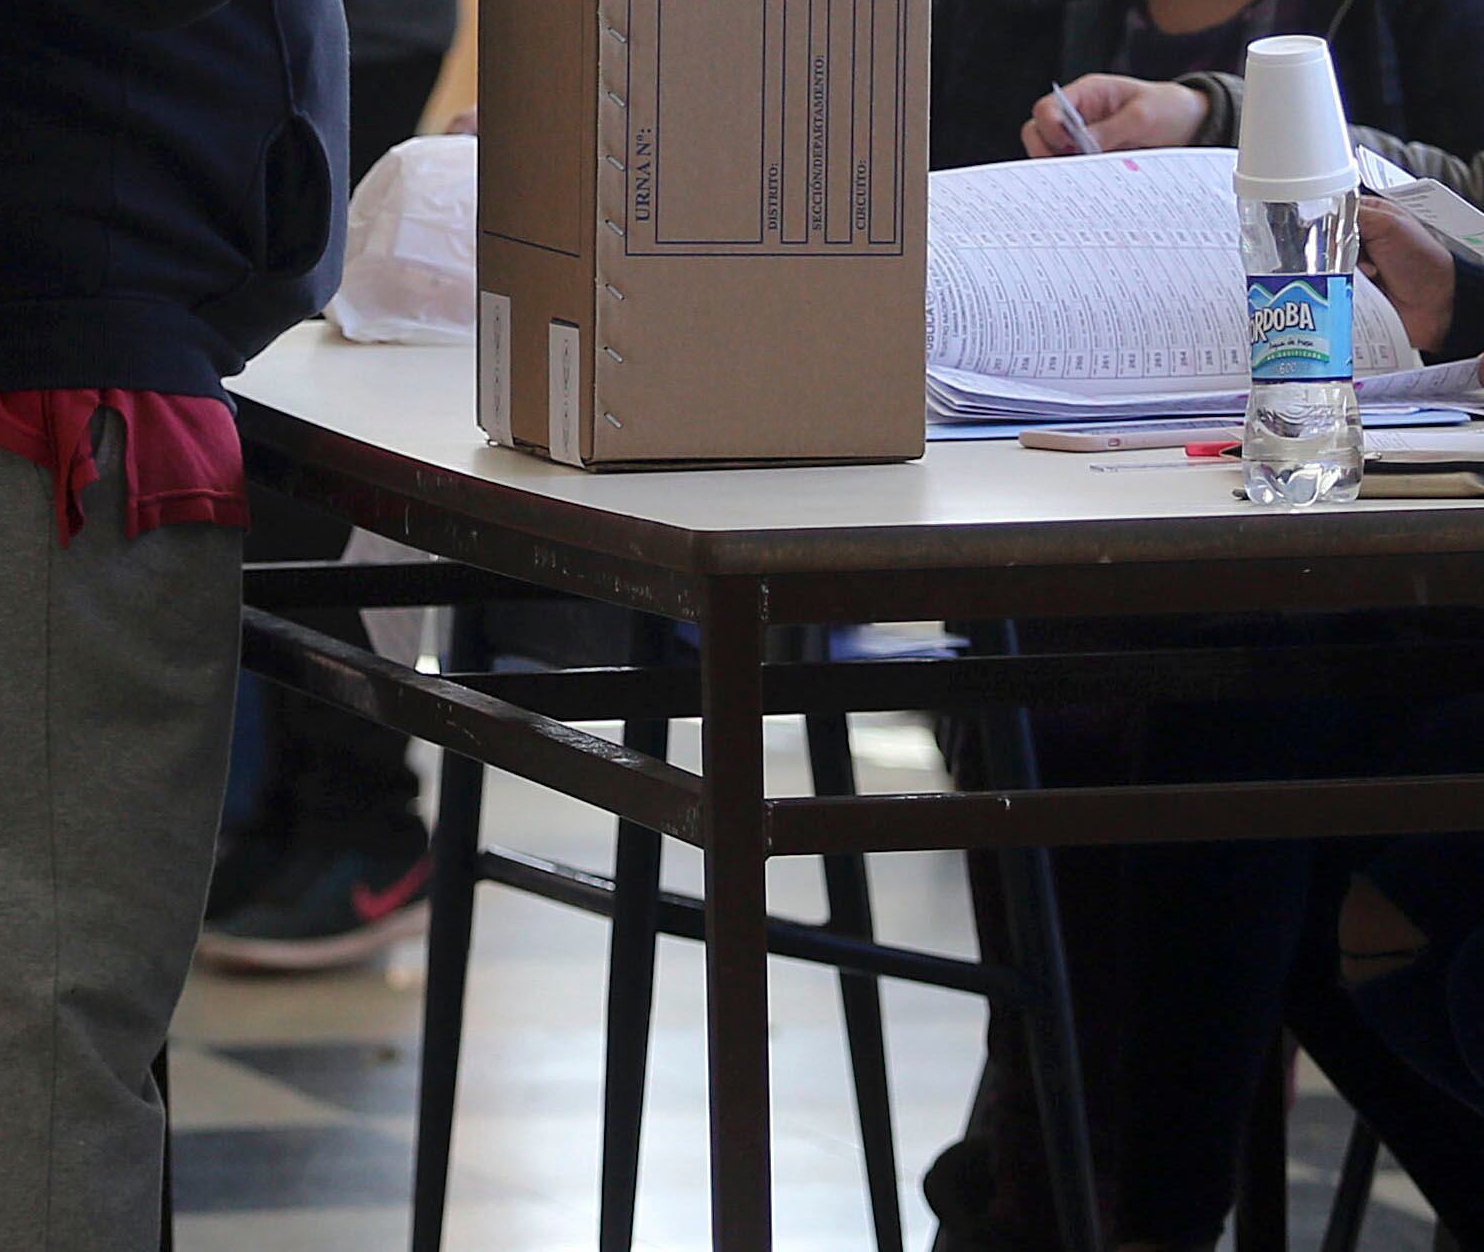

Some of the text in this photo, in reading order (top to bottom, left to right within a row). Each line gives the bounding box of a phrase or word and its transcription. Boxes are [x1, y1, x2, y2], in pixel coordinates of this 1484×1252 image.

[808, 53, 825, 231] SECCIÓN/DEPARTAMENTO:
[635, 160, 652, 222] URNA
[767, 162, 779, 231] DISTRITO:
